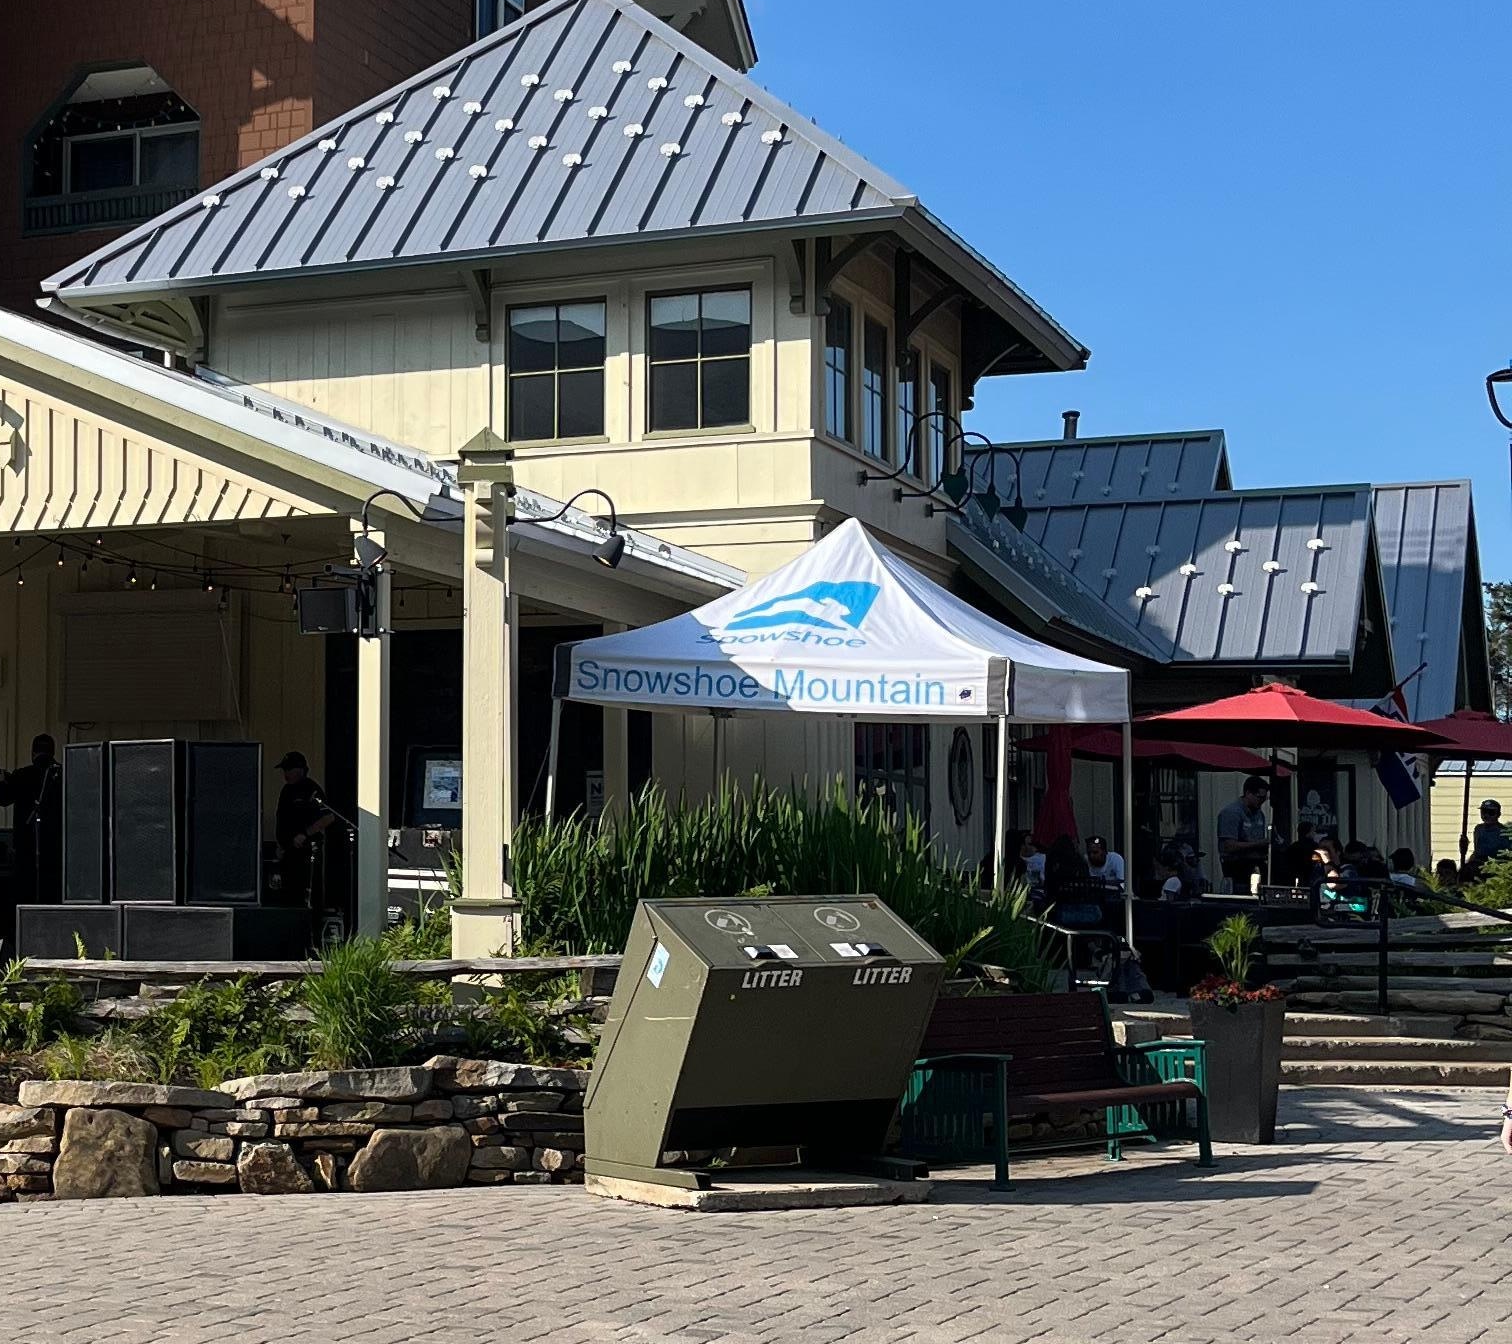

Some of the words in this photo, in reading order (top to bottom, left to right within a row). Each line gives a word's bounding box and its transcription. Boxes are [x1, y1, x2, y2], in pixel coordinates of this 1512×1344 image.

[576, 660, 759, 698] Snowshoe
[773, 668, 946, 706] Mountain
[741, 969, 804, 989] LITTER
[852, 966, 913, 986] LITTER
